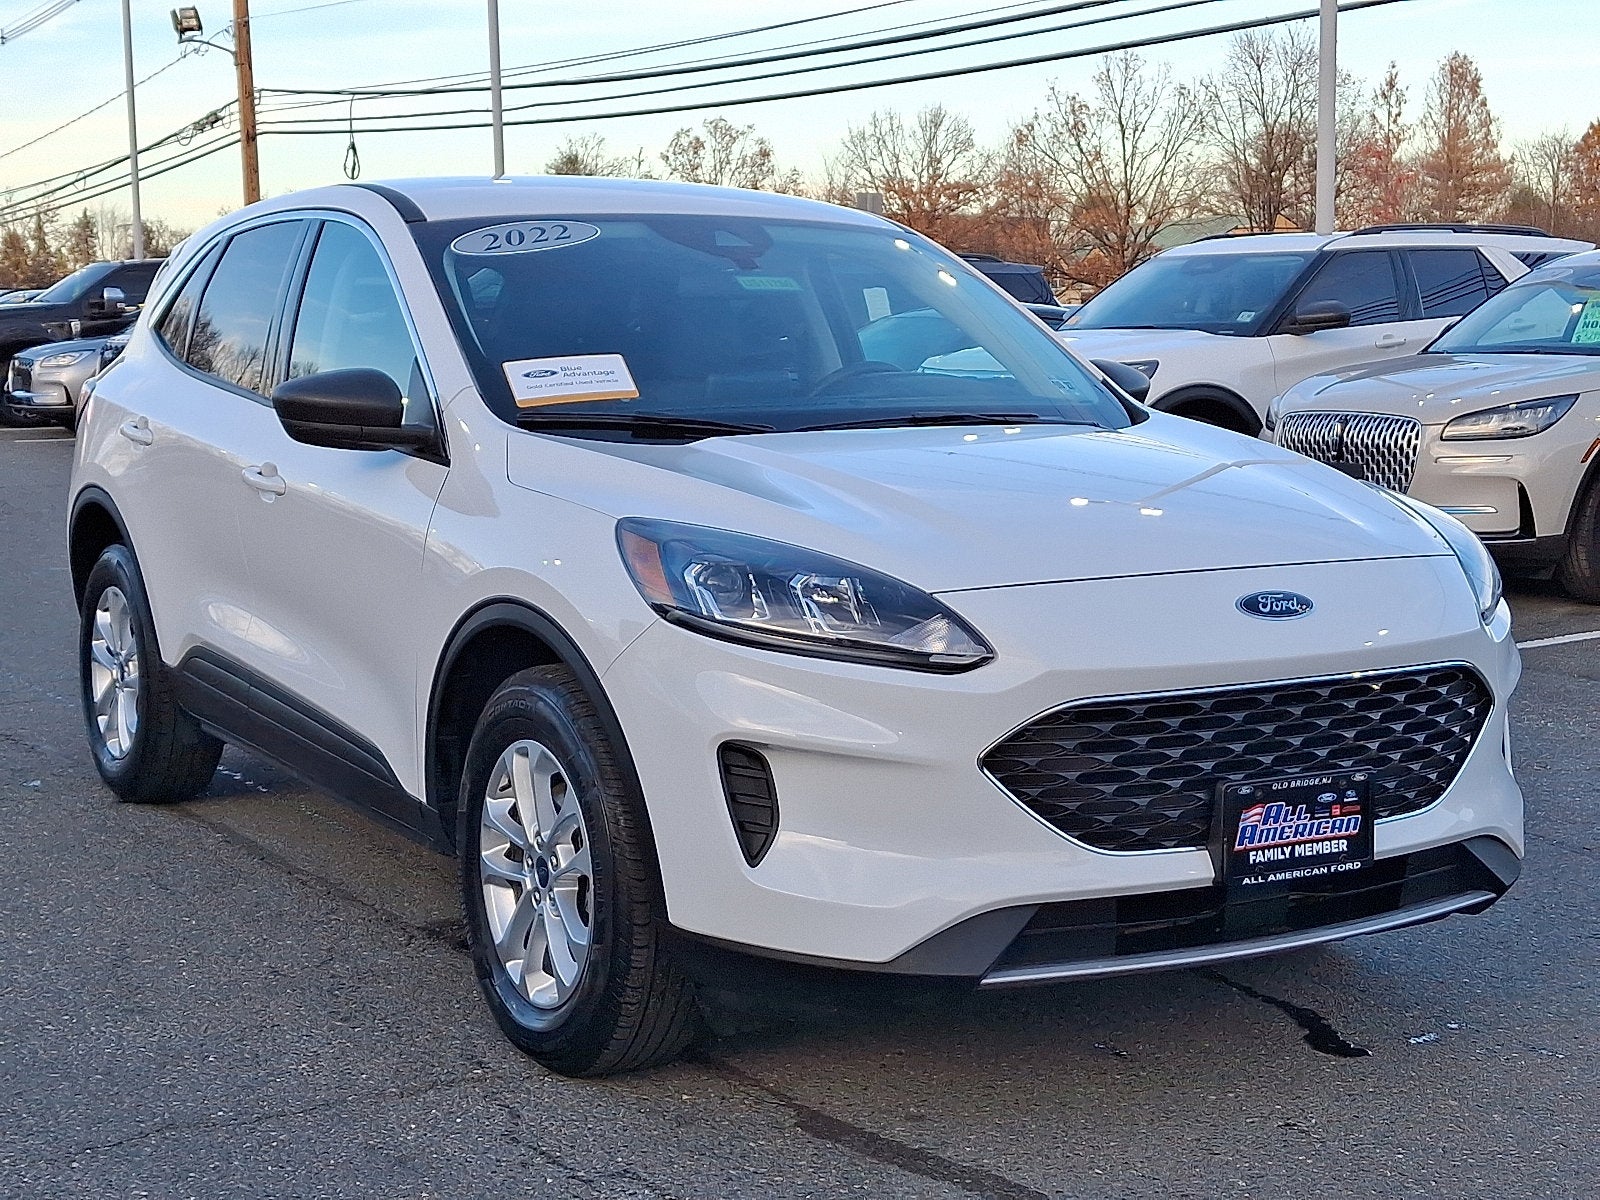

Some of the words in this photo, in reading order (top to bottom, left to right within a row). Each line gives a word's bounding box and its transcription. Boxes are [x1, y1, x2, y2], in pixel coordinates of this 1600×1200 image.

[481, 224, 572, 251] 2022
[1582, 320, 1600, 329] NO
[562, 369, 615, 378] Advantage
[1257, 594, 1300, 613] Ford
[1272, 782, 1288, 790] OLD
[1262, 802, 1310, 826] ALL
[1236, 815, 1361, 848] AMERICAN
[1249, 845, 1292, 864] FAMILY
[1294, 839, 1348, 858] MEMBER
[1242, 875, 1266, 885] ALL
[1267, 867, 1328, 882] AMERICAN
[1330, 861, 1362, 873] FORD
